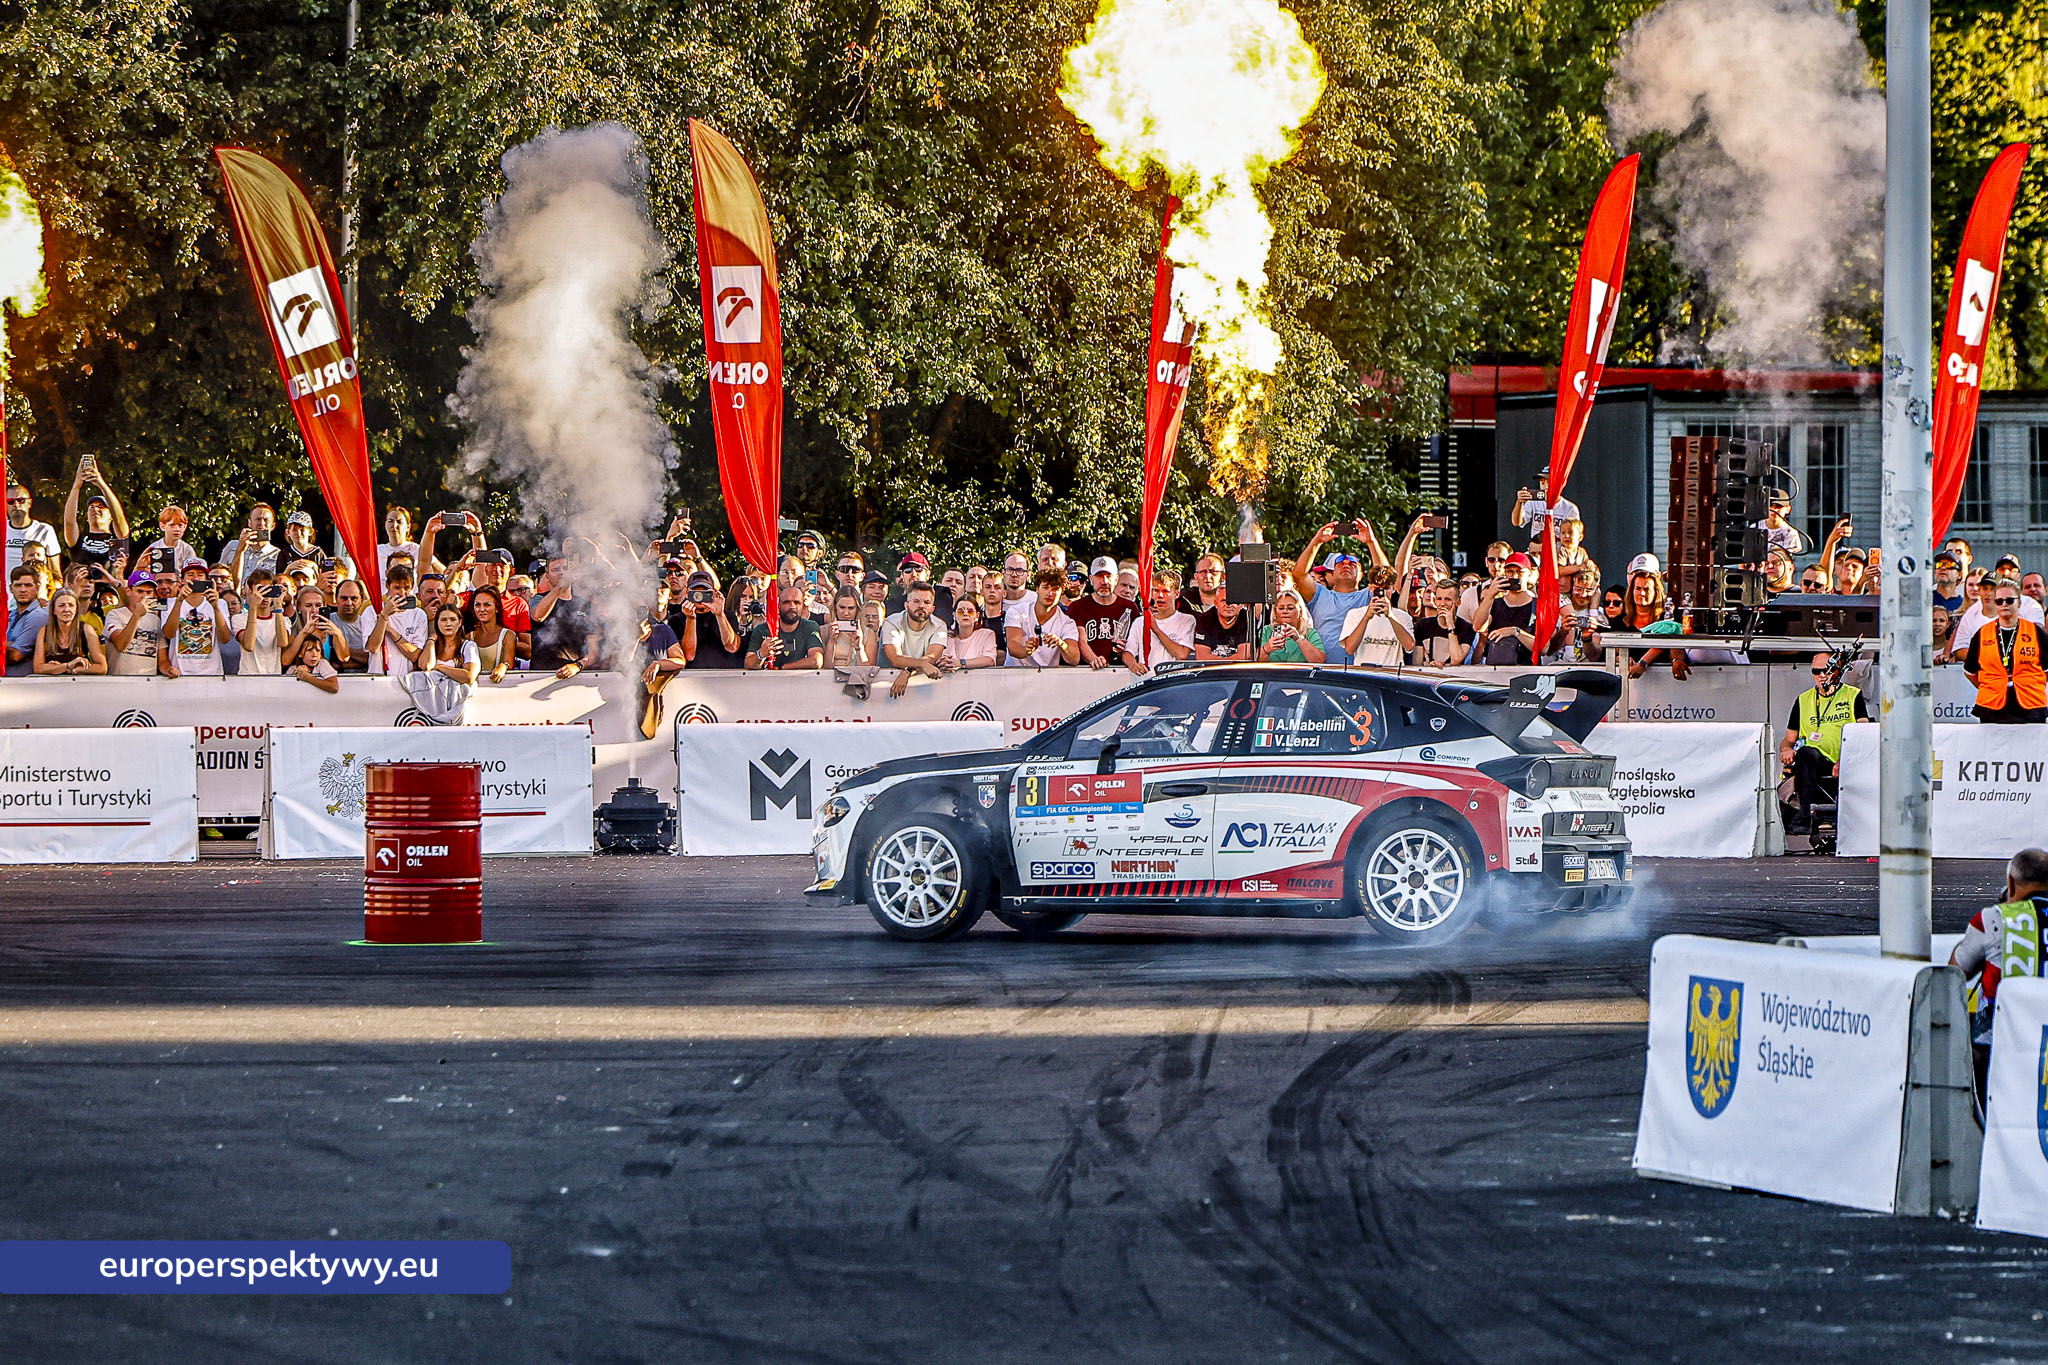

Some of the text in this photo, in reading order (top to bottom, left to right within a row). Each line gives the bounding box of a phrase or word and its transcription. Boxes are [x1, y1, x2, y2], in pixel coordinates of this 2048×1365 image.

[2020, 647, 2037, 657] 455
[1614, 704, 1715, 720] ewództwo
[1276, 719, 1346, 731] A.Mabellini
[1350, 711, 1373, 746] 3
[1275, 735, 1320, 747] V.Lenzi
[1959, 761, 2045, 782] KATOW
[480, 779, 546, 799] rystyki
[1094, 780, 1126, 788] ORLEN
[1025, 777, 1038, 806] 3
[1958, 788, 2031, 805] dla odmiany
[59, 789, 62, 805] i
[68, 789, 151, 809] Turystyki
[1046, 806, 1057, 814] FIA
[1071, 804, 1113, 814] Championship
[1273, 823, 1325, 834] TEAM
[1508, 826, 1541, 837] IVAR
[1220, 822, 1268, 848] ACI
[1268, 836, 1326, 847] ITALIA
[406, 845, 449, 857] ORLEN
[1096, 848, 1205, 856] INTEGRALE
[406, 858, 422, 867] OIL
[1111, 861, 1175, 873] NORTHON
[1032, 863, 1095, 877] sparco
[1241, 880, 1259, 891] CSI
[2004, 913, 2035, 976] 275
[1761, 992, 1871, 1037] Województwo
[1757, 1036, 1815, 1083] Śląskie
